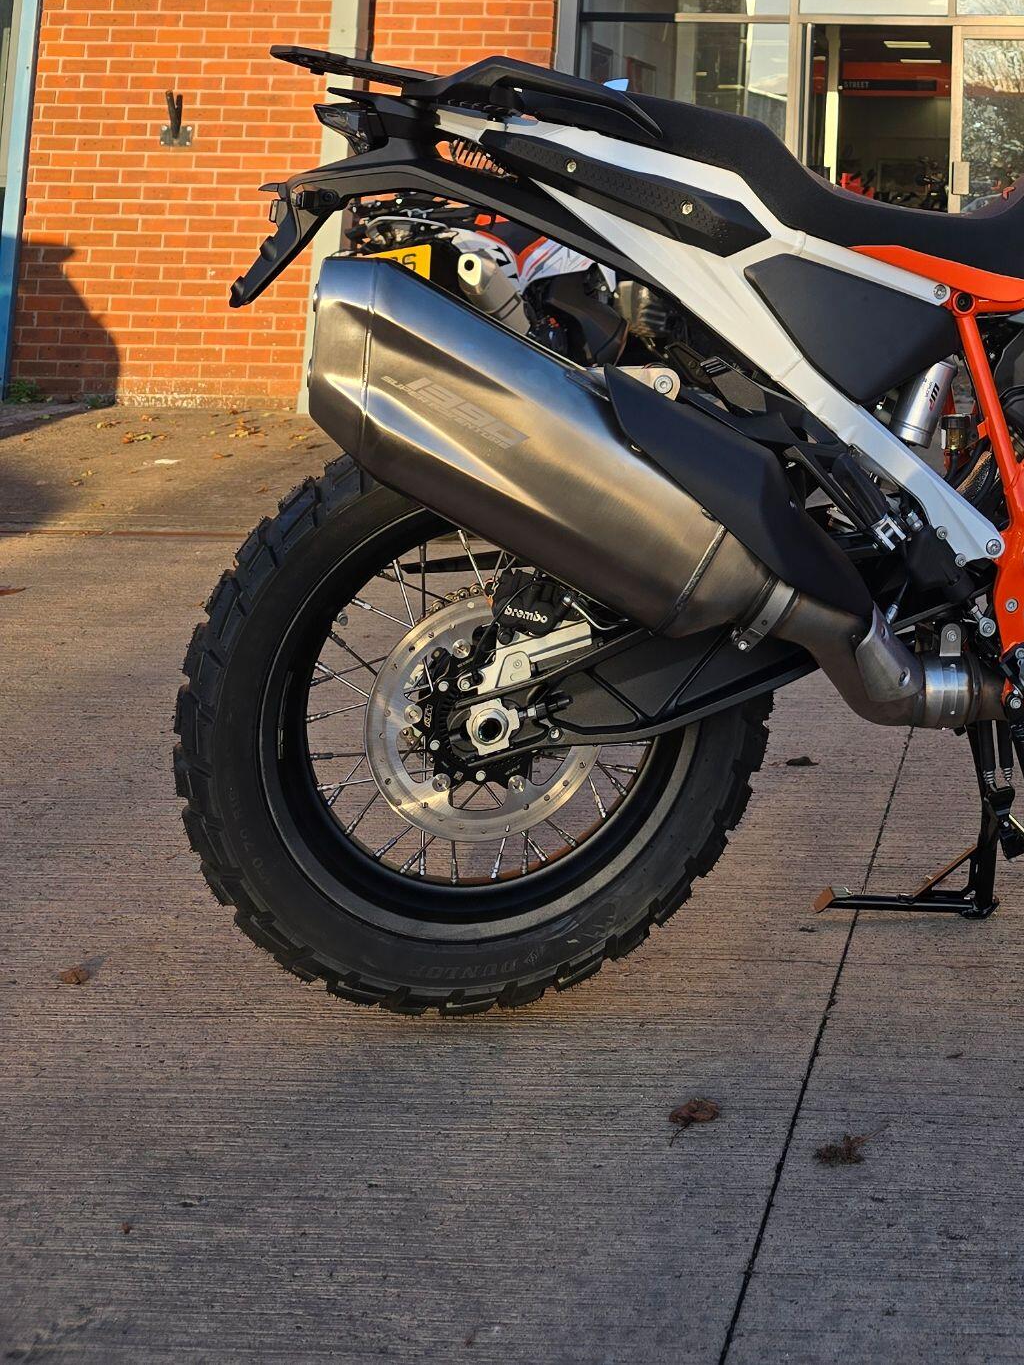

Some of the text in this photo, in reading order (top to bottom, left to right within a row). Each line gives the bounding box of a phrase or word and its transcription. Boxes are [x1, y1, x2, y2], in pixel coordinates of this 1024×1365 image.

[843, 81, 870, 89] STREET
[405, 376, 530, 446] 1390
[504, 604, 548, 624] brembo
